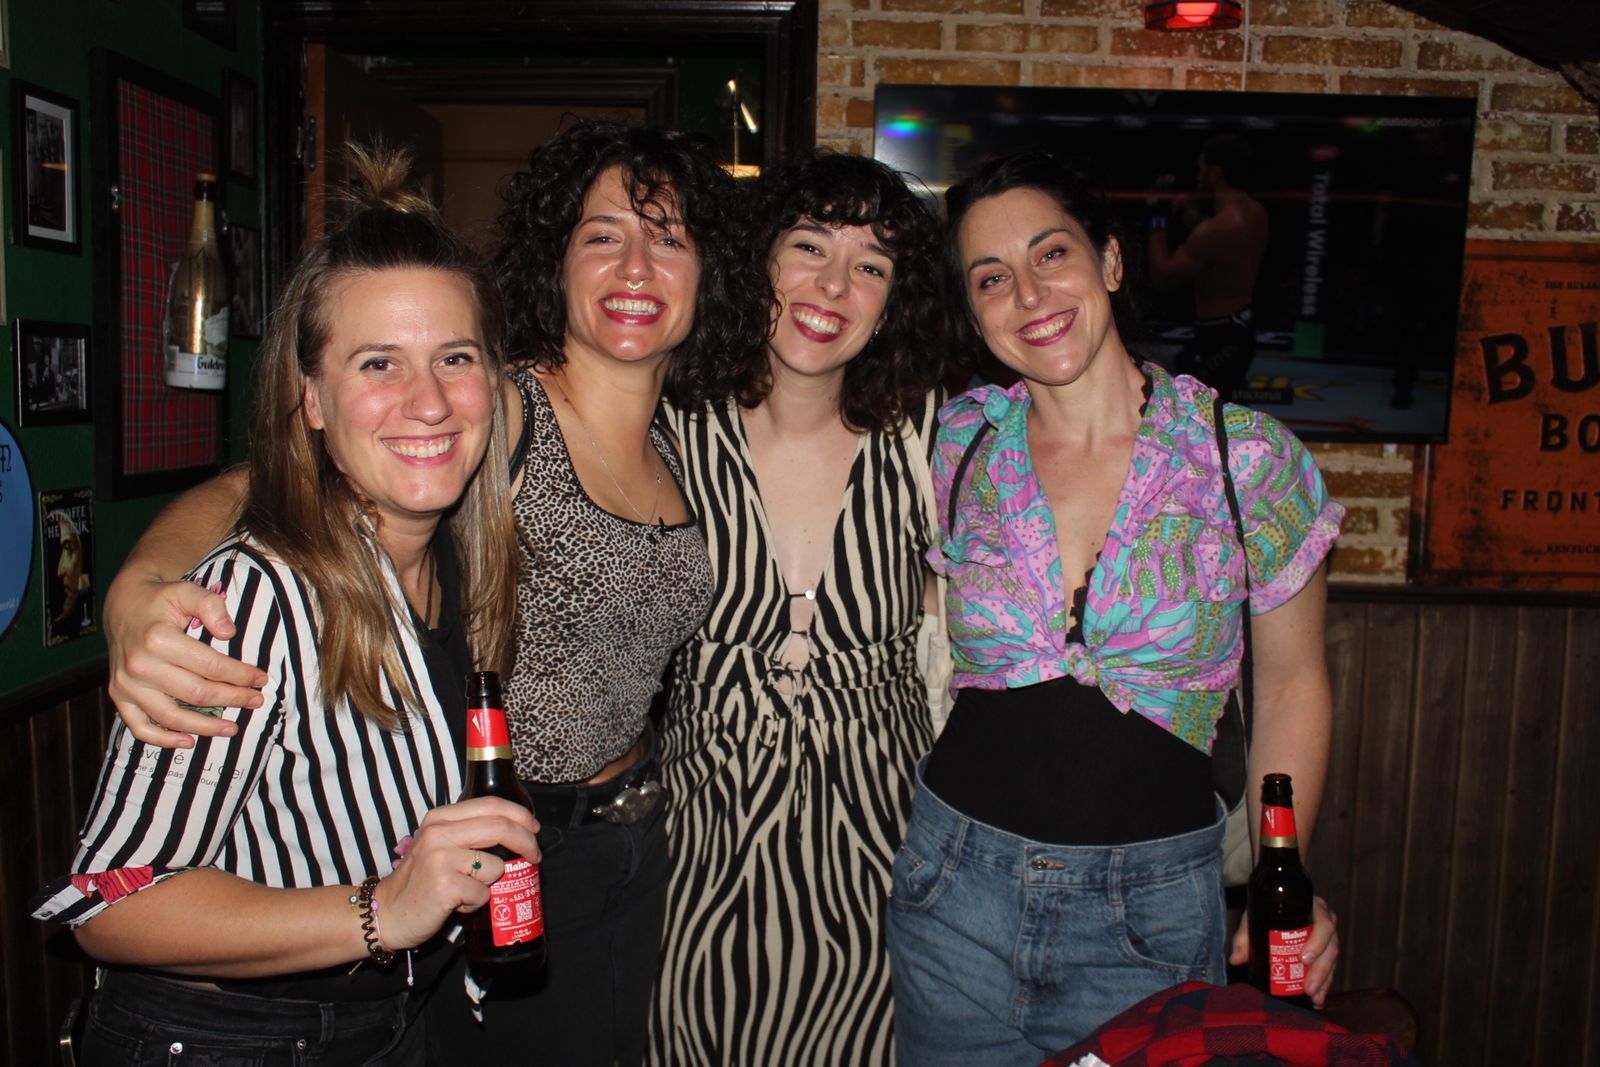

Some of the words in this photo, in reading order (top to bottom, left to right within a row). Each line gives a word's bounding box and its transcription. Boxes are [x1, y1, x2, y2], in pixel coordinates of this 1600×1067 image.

[1310, 171, 1333, 225] Total
[1301, 229, 1327, 316] Wireless
[1540, 413, 1600, 454] BO
[168, 770, 184, 779] pas
